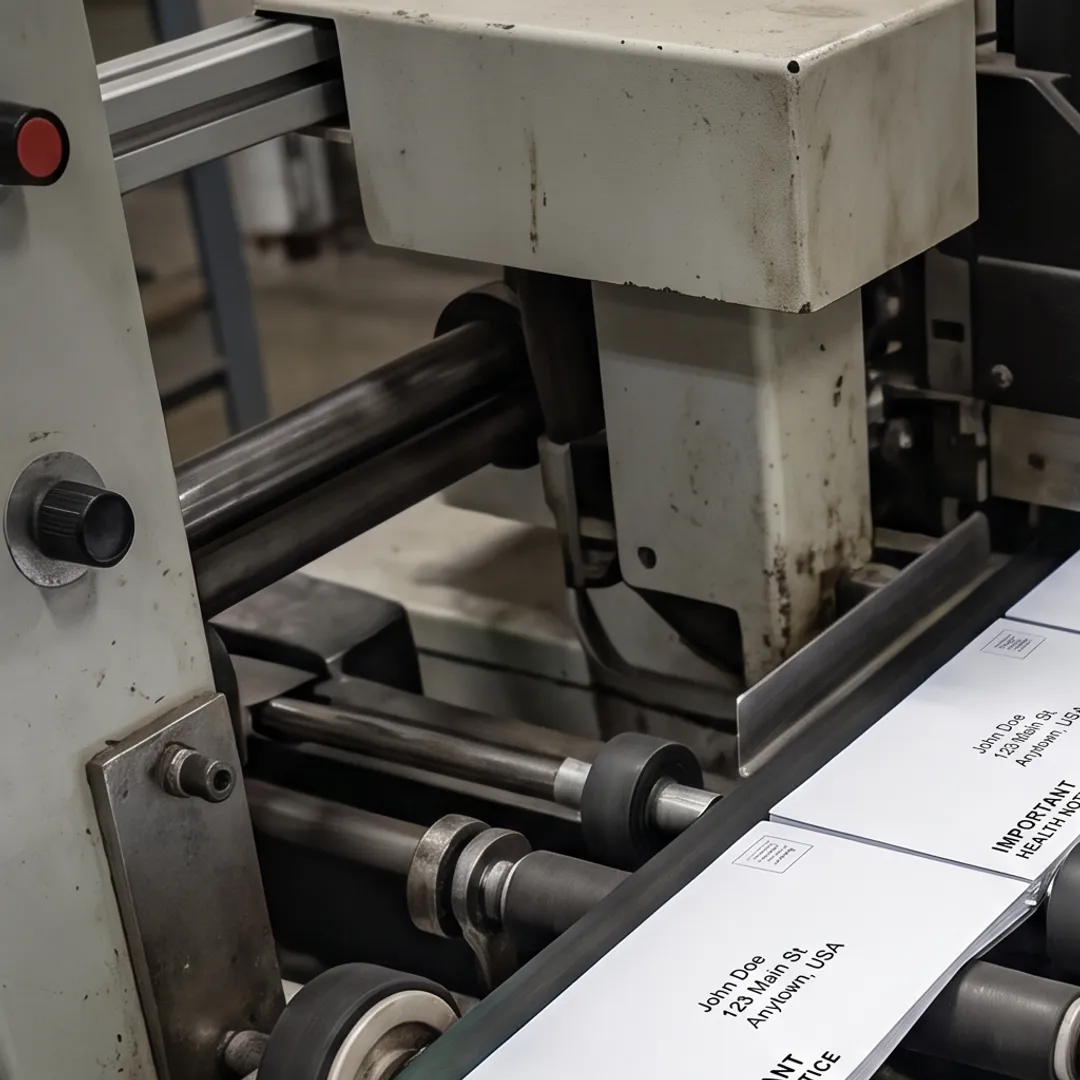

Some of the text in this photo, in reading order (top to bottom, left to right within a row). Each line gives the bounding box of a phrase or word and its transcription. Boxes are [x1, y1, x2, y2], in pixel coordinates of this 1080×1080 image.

[972, 714, 1026, 755] John Doe
[994, 743, 1020, 759] 123
[991, 779, 1076, 853] IMPORTANT
[1015, 817, 1066, 860] HEALTH
[805, 943, 846, 970] USA
[698, 955, 766, 1013] John Doe
[723, 995, 754, 1018] 123
[746, 969, 790, 995] Main
